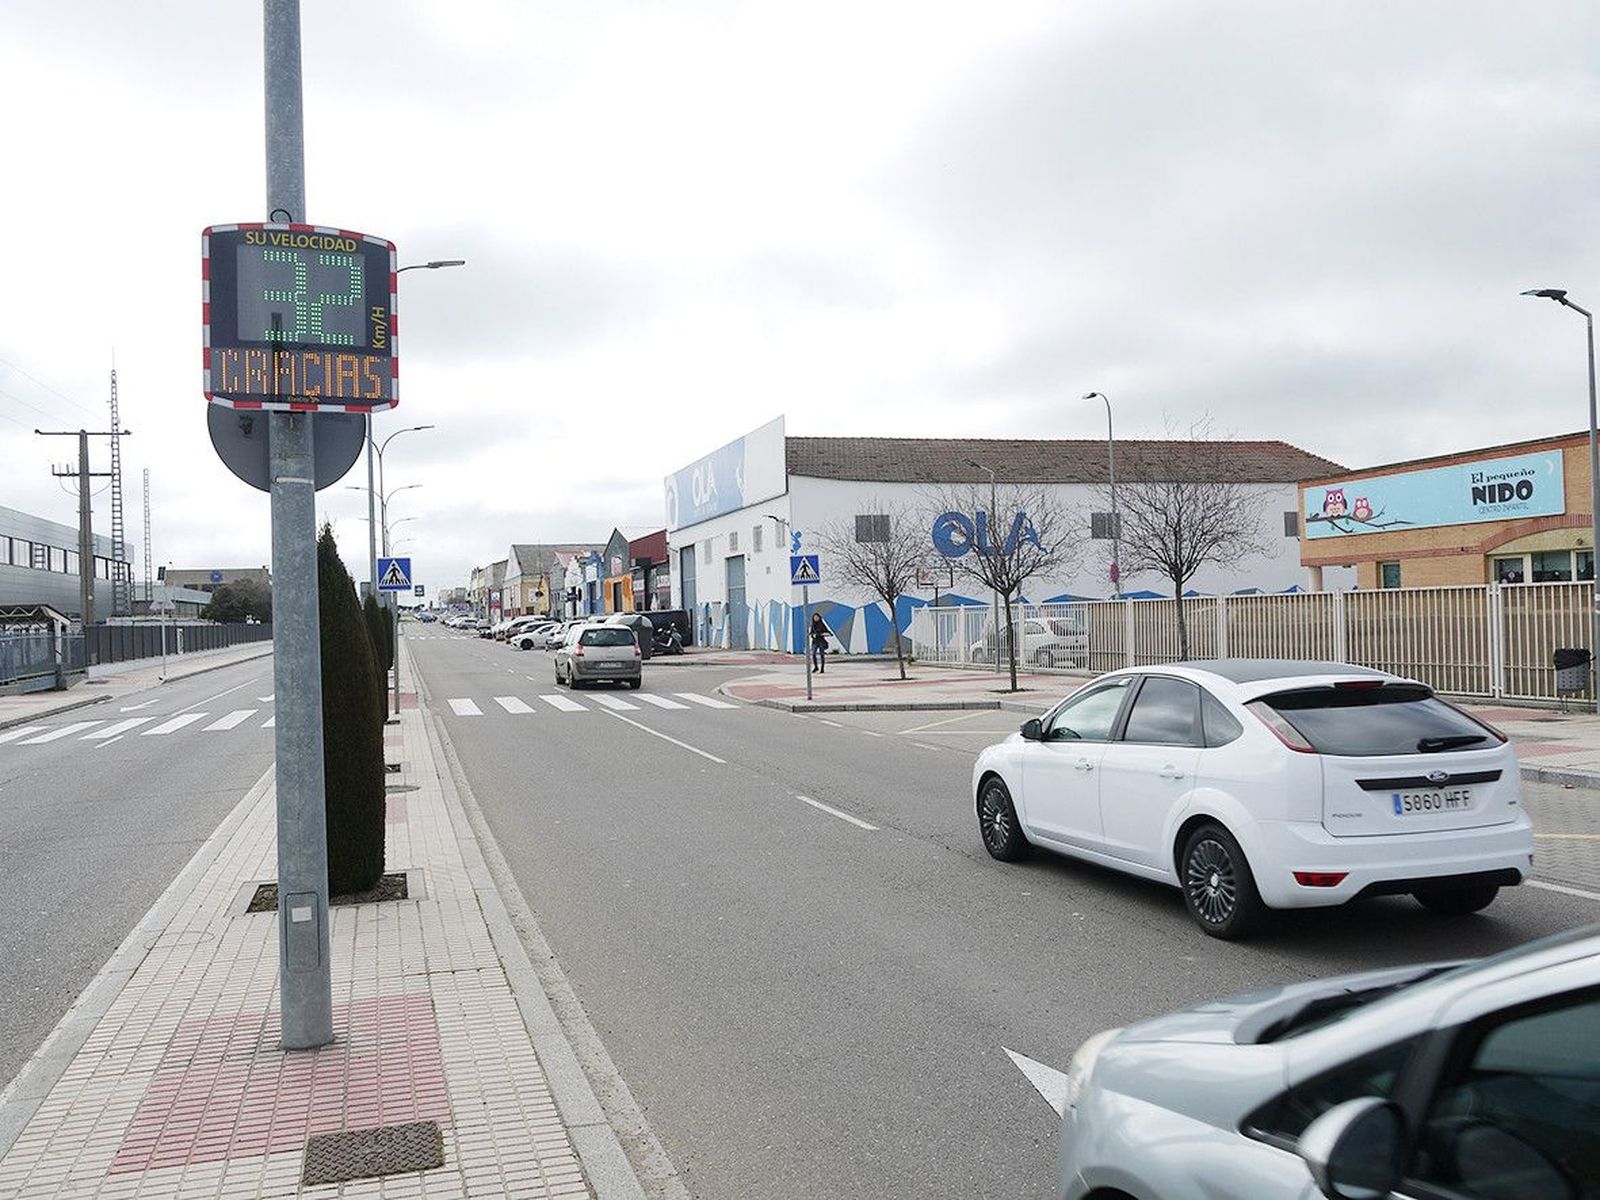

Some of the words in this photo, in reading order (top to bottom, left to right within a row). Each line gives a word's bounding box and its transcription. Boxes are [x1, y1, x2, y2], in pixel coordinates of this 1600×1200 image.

[245, 232, 267, 245] SU
[270, 233, 357, 252] VELOCIDAD
[263, 250, 362, 345] 32
[371, 306, 387, 349] Km/H
[692, 461, 720, 507] OLA
[1471, 472, 1483, 483] El
[1487, 469, 1535, 482] pequeño
[1472, 479, 1533, 505] NIDO
[932, 511, 1048, 558] OLA
[1403, 792, 1442, 812] 5860
[1444, 789, 1470, 809] HFF
